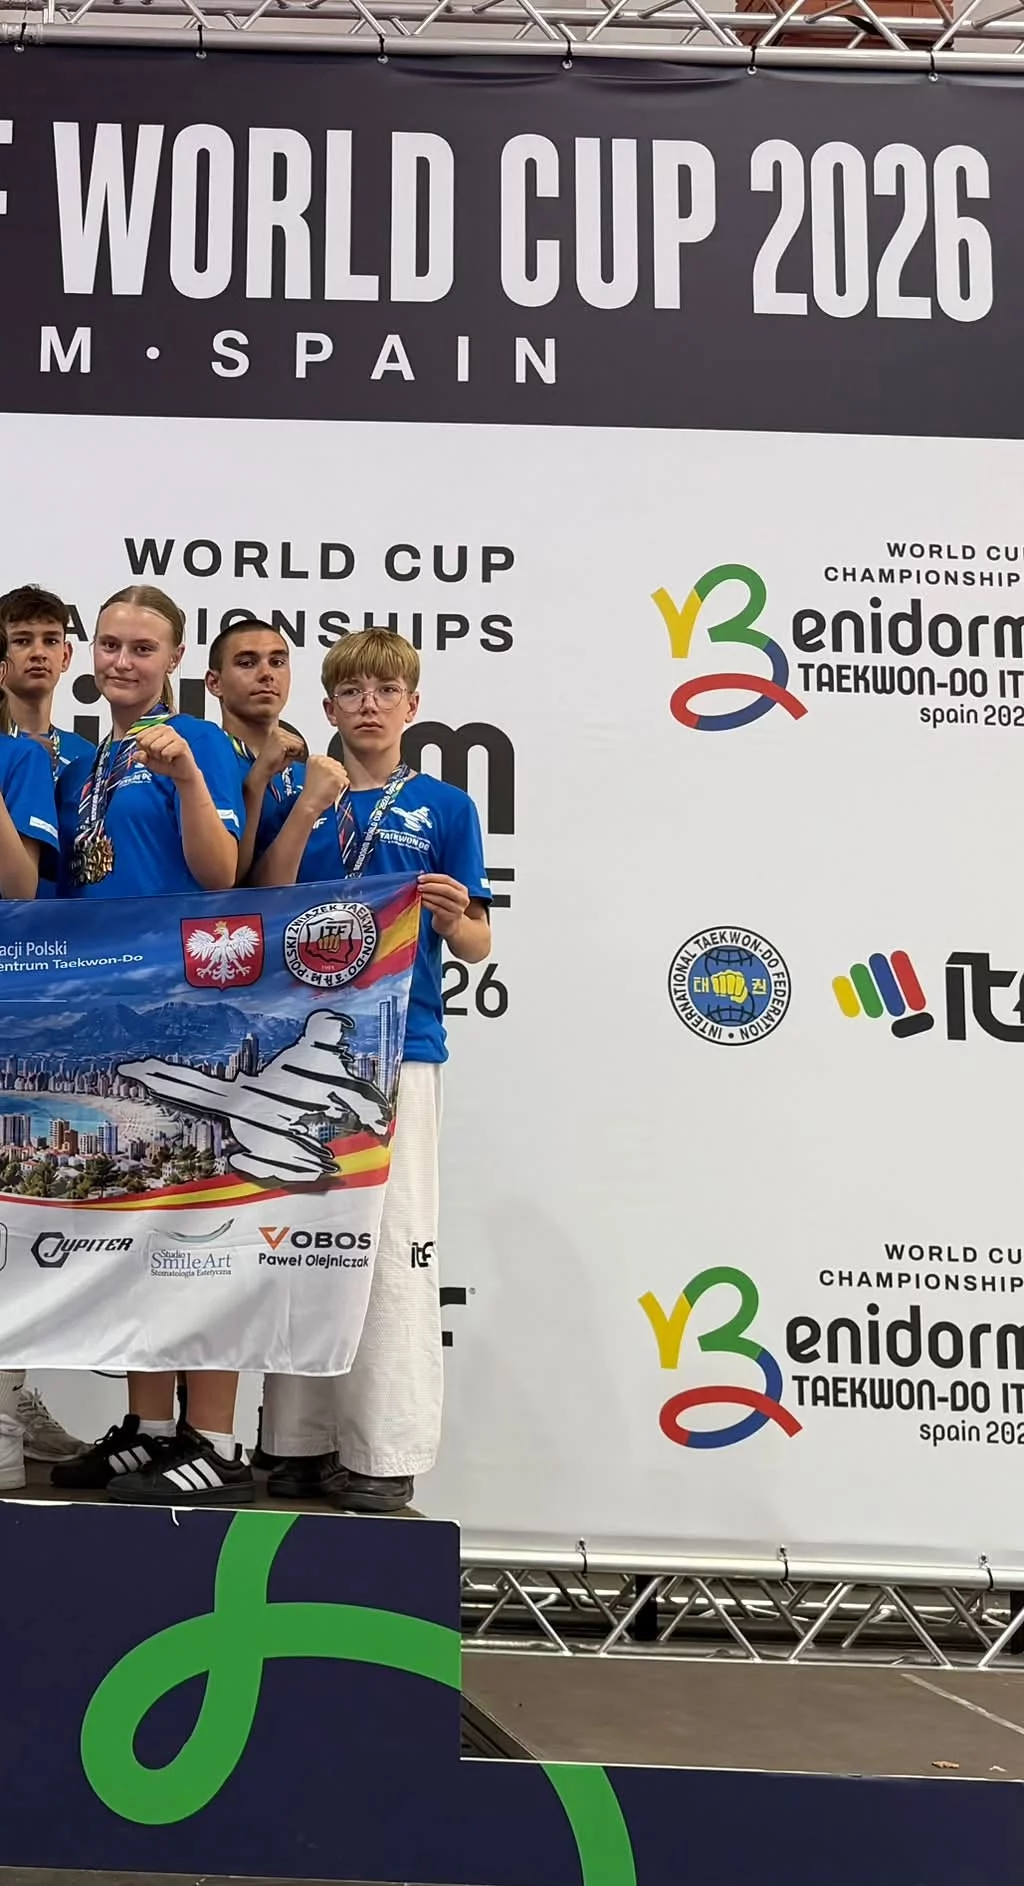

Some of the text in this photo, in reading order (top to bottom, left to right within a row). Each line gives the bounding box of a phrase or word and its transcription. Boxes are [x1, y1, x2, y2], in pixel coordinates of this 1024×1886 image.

[53, 121, 455, 304] WORLD
[500, 133, 716, 309] CUP
[750, 138, 994, 323] 2026
[210, 329, 557, 384] SPAIN
[124, 537, 516, 584] WORLD CUP
[886, 541, 1024, 562] WORLD CU
[823, 566, 1021, 588] CHAMPIONSHIP
[797, 662, 1024, 699] TAEKWON-DO IT
[919, 702, 1024, 729] spain 202
[26, 940, 67, 956] Polski
[52, 954, 144, 969] Taekwon-Do
[673, 930, 787, 1041] INTERNATIONAL TAEKWON-DO FEDERATION
[258, 1253, 369, 1269] Paweł Olejniczak
[884, 1243, 1023, 1265] WORLD CU
[819, 1269, 1024, 1293] CHAMPIONSHIP
[792, 1375, 1024, 1414] TAEKWON-DO IT
[919, 1420, 1024, 1447] spain 202
